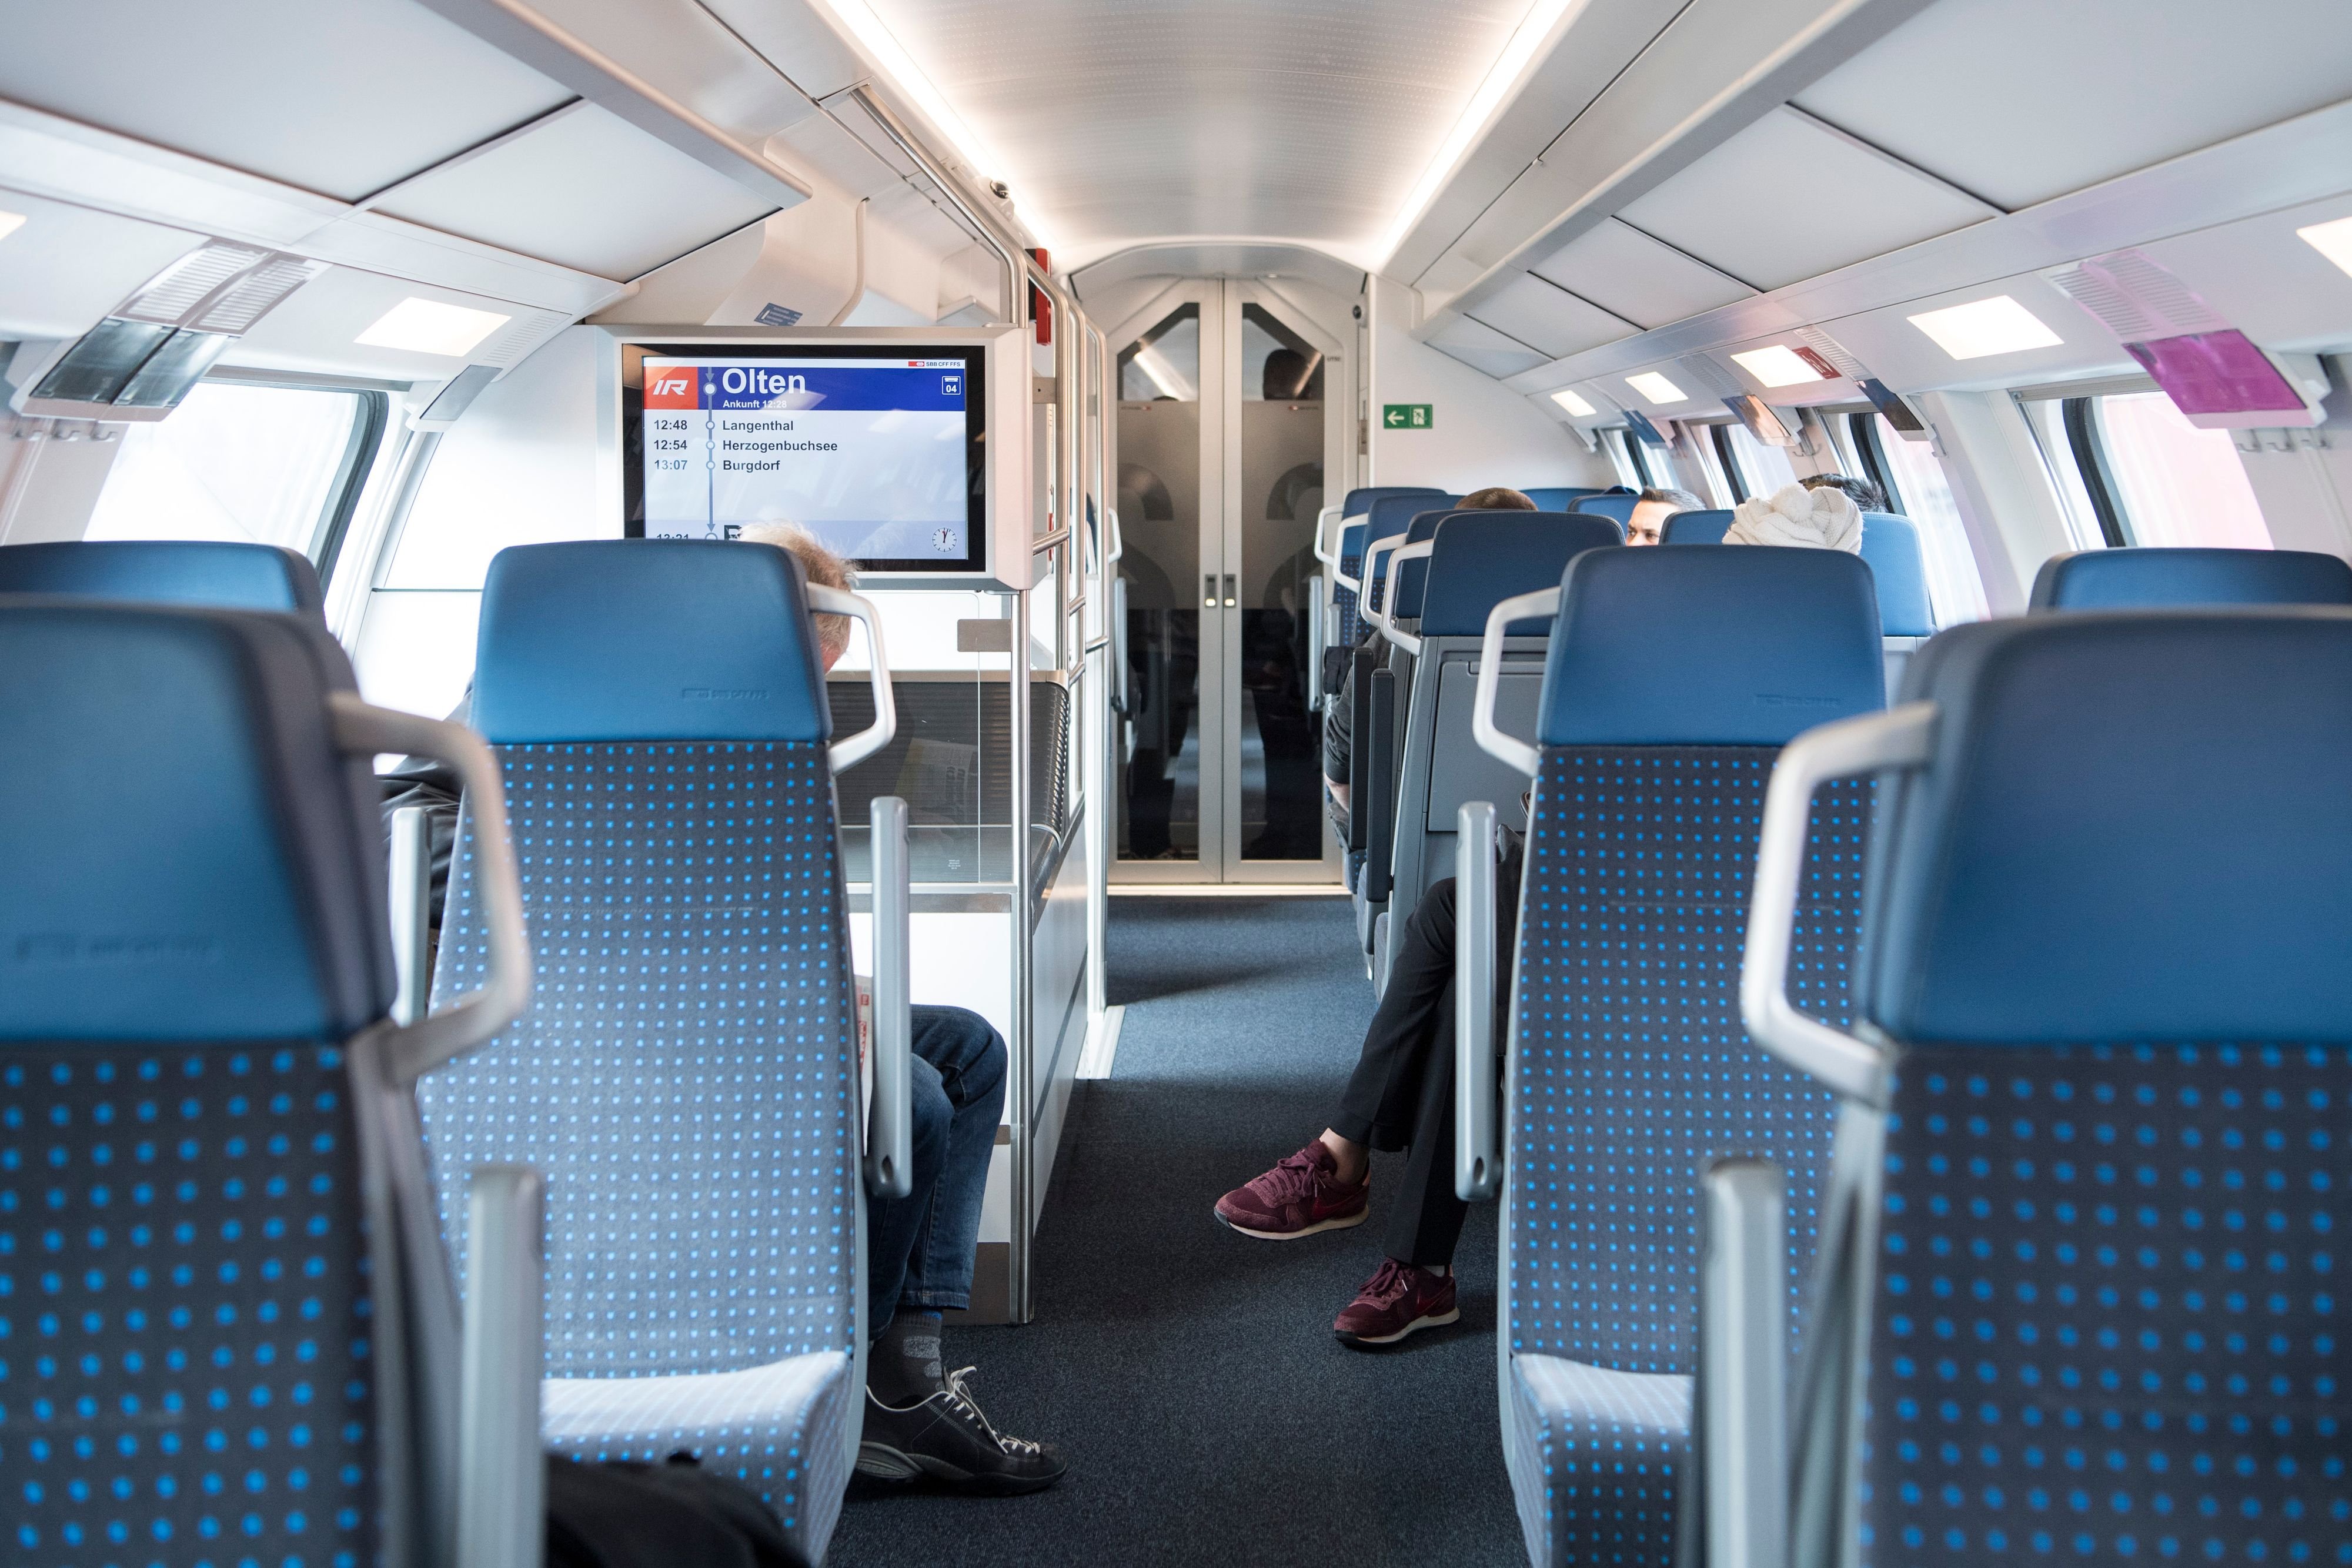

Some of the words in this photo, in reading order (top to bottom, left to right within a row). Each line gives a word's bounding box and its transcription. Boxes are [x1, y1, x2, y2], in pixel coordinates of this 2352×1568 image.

[653, 379, 689, 396] IR
[722, 368, 806, 394] Olten
[946, 385, 957, 393] 04
[723, 400, 760, 409] Ankunft
[763, 400, 787, 409] 12:28
[654, 420, 687, 430] 12:48
[723, 420, 793, 433] Langenthal
[654, 439, 687, 450] 12:54
[723, 440, 838, 453] Herzogenbuchsee
[654, 459, 688, 470] 13:07
[723, 460, 780, 473] Burgdorf
